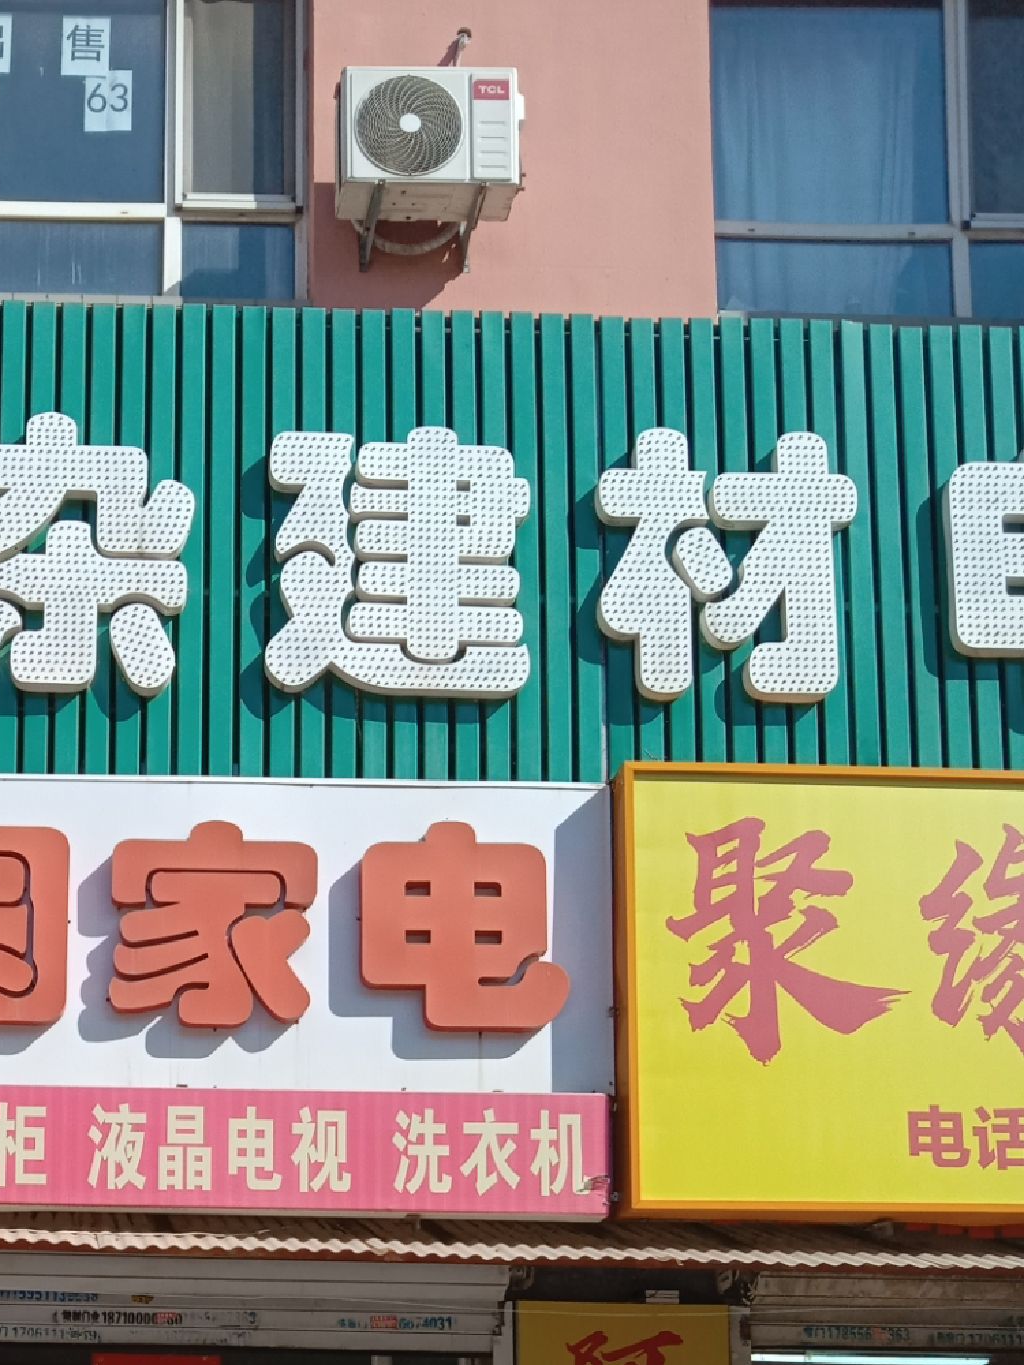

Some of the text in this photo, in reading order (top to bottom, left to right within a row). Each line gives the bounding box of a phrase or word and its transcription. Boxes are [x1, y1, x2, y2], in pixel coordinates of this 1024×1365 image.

[87, 82, 129, 113] 63
[477, 84, 505, 95] TCL
[87, 1102, 352, 1194] 液晶电视
[392, 1107, 593, 1198] 洗衣机
